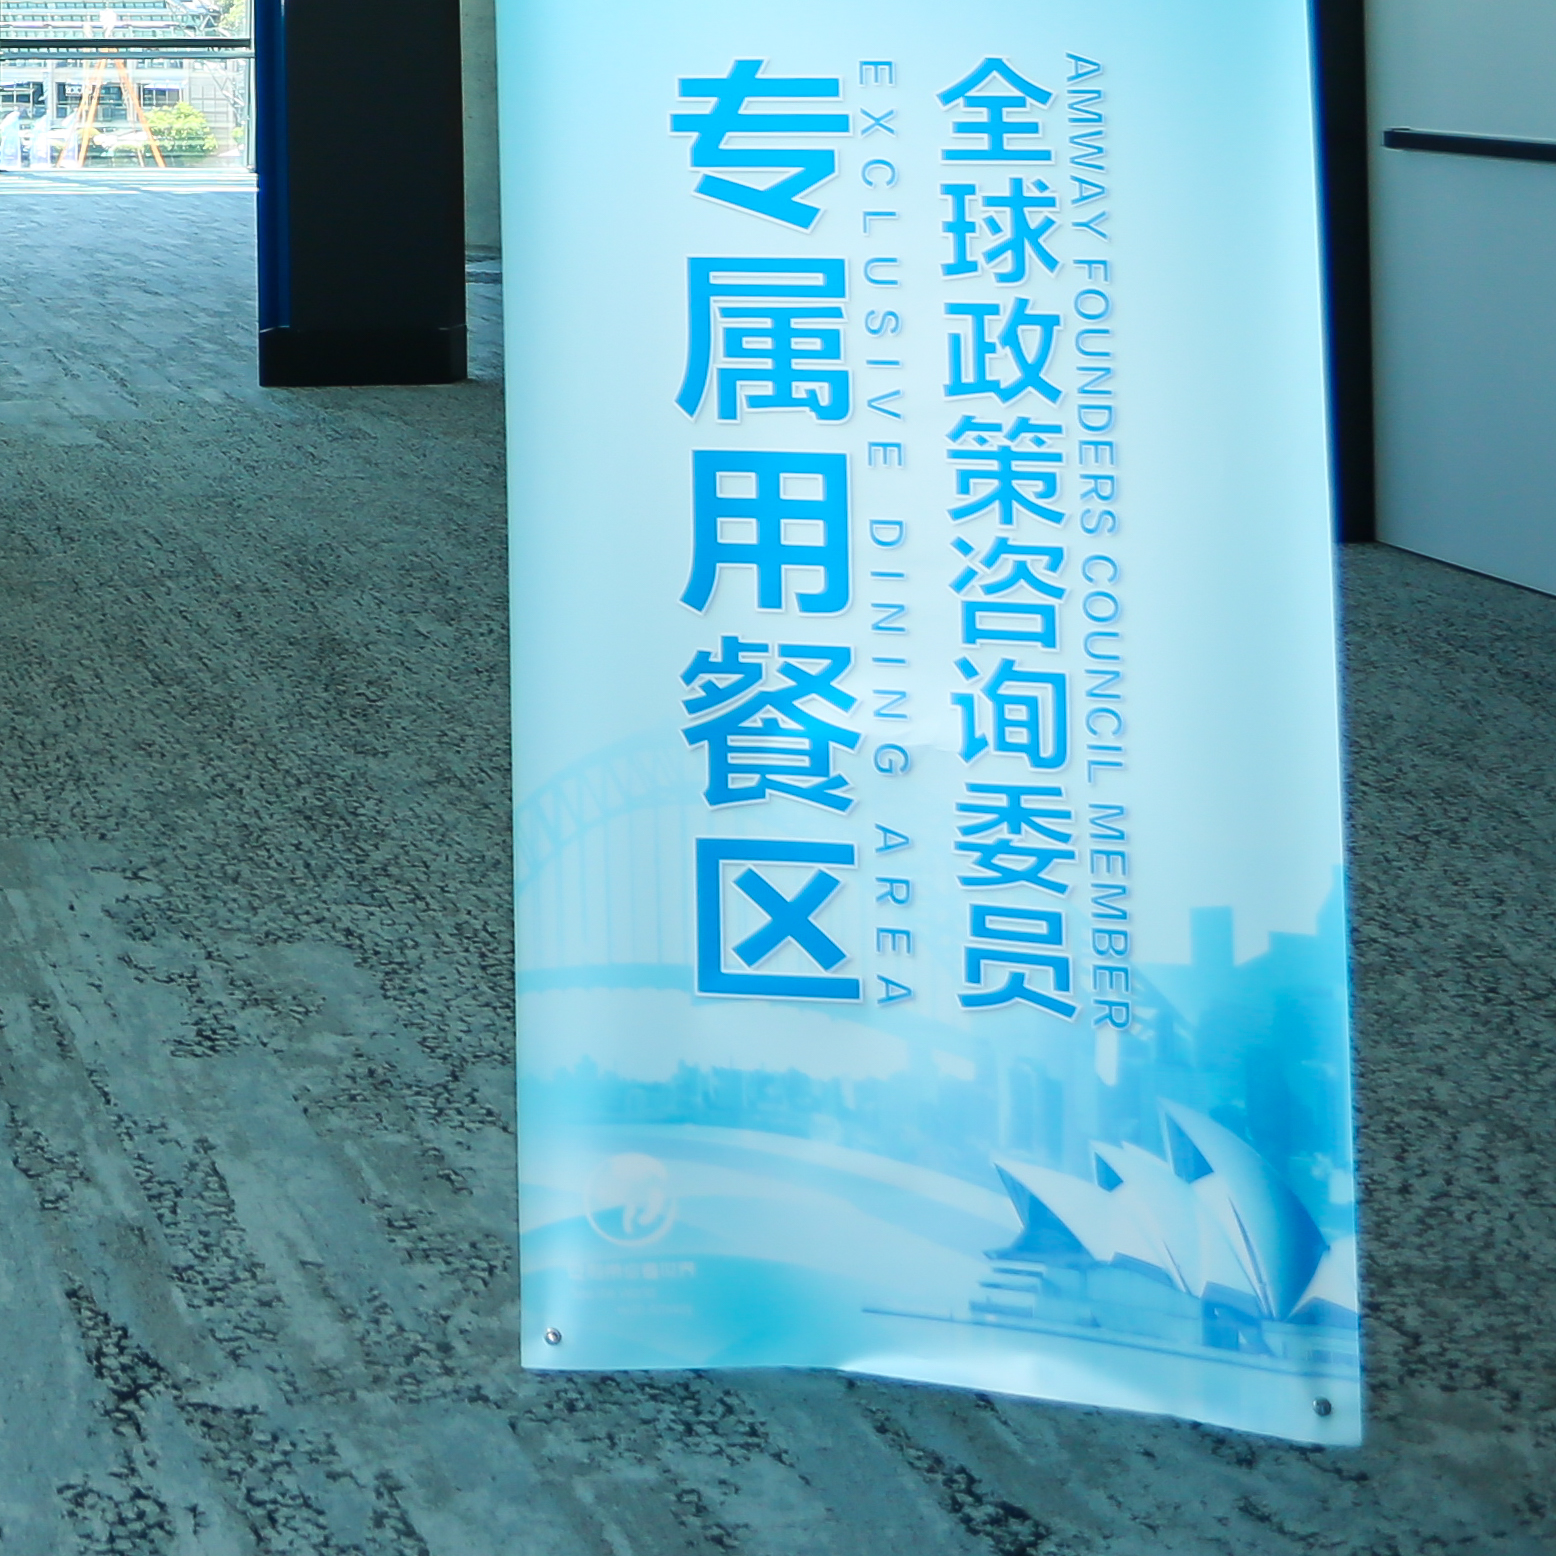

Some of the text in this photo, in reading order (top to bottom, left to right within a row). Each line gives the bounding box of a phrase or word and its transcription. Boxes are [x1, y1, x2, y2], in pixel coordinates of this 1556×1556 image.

[669, 58, 862, 1001] 专属用餐区
[858, 59, 915, 1006] EXCLUSIVE DINING AREA
[936, 56, 1078, 1020] 全球政策咨询委员
[1063, 51, 1134, 1032] AMWAY FOUNDERS COUNCIL MEMBER
